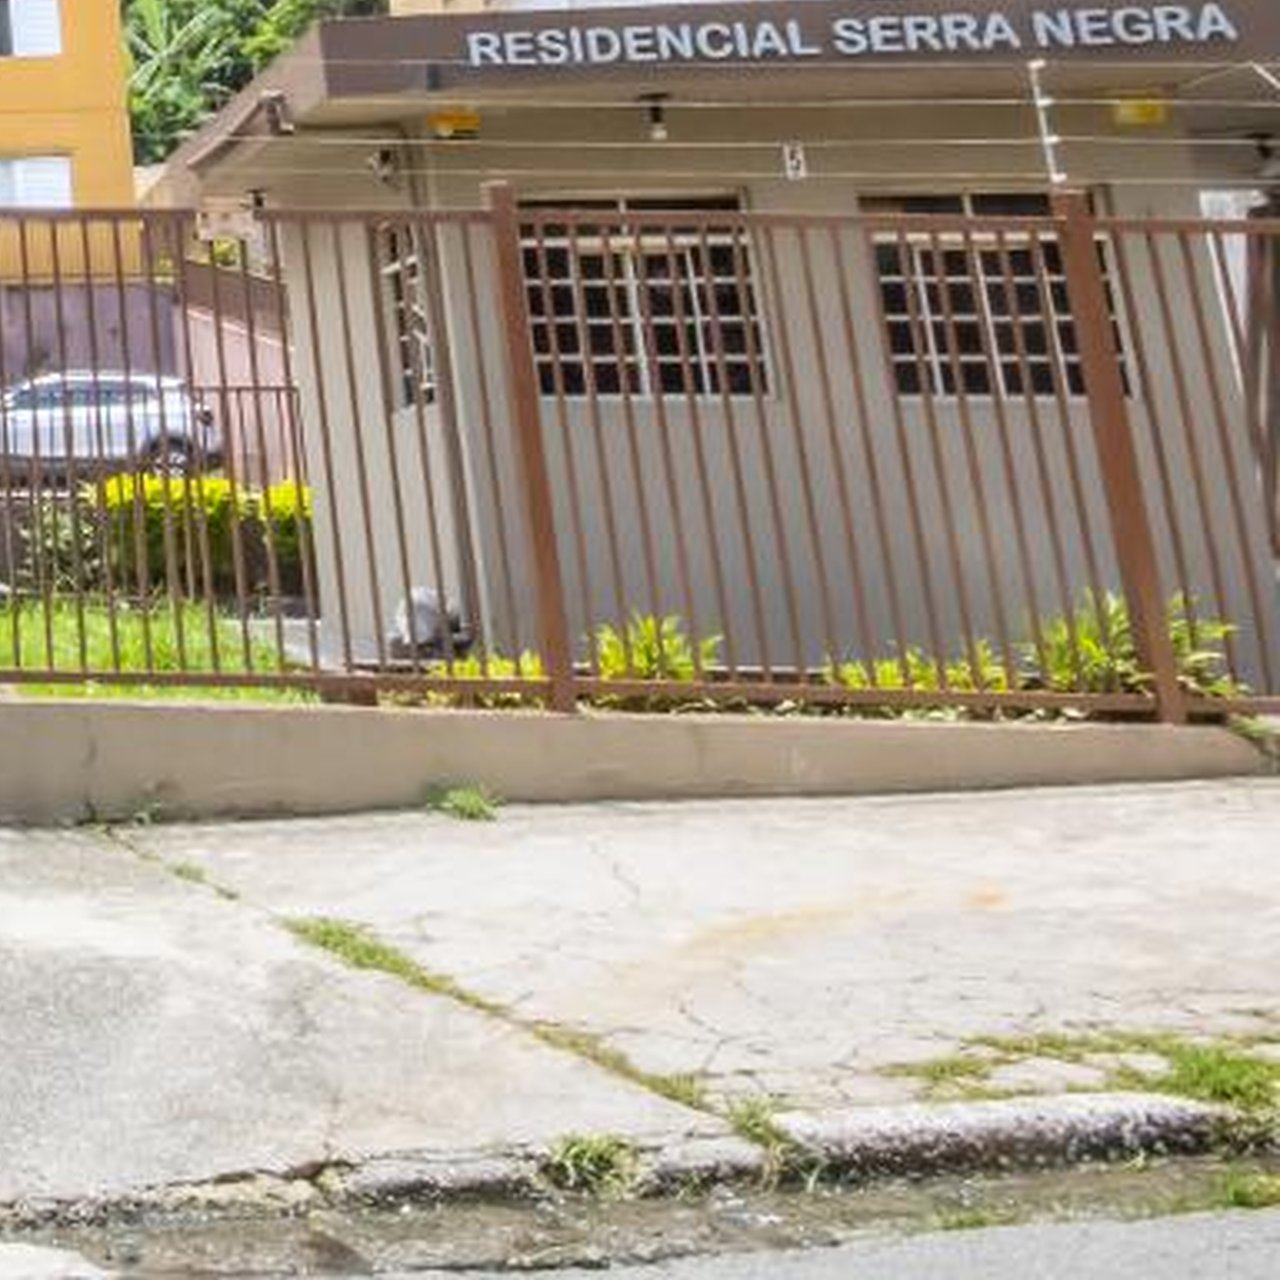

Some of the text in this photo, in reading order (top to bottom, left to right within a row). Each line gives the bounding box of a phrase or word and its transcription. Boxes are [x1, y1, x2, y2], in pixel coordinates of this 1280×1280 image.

[467, 3, 1238, 67] RESIDENCIAL SERRA NEGRA
